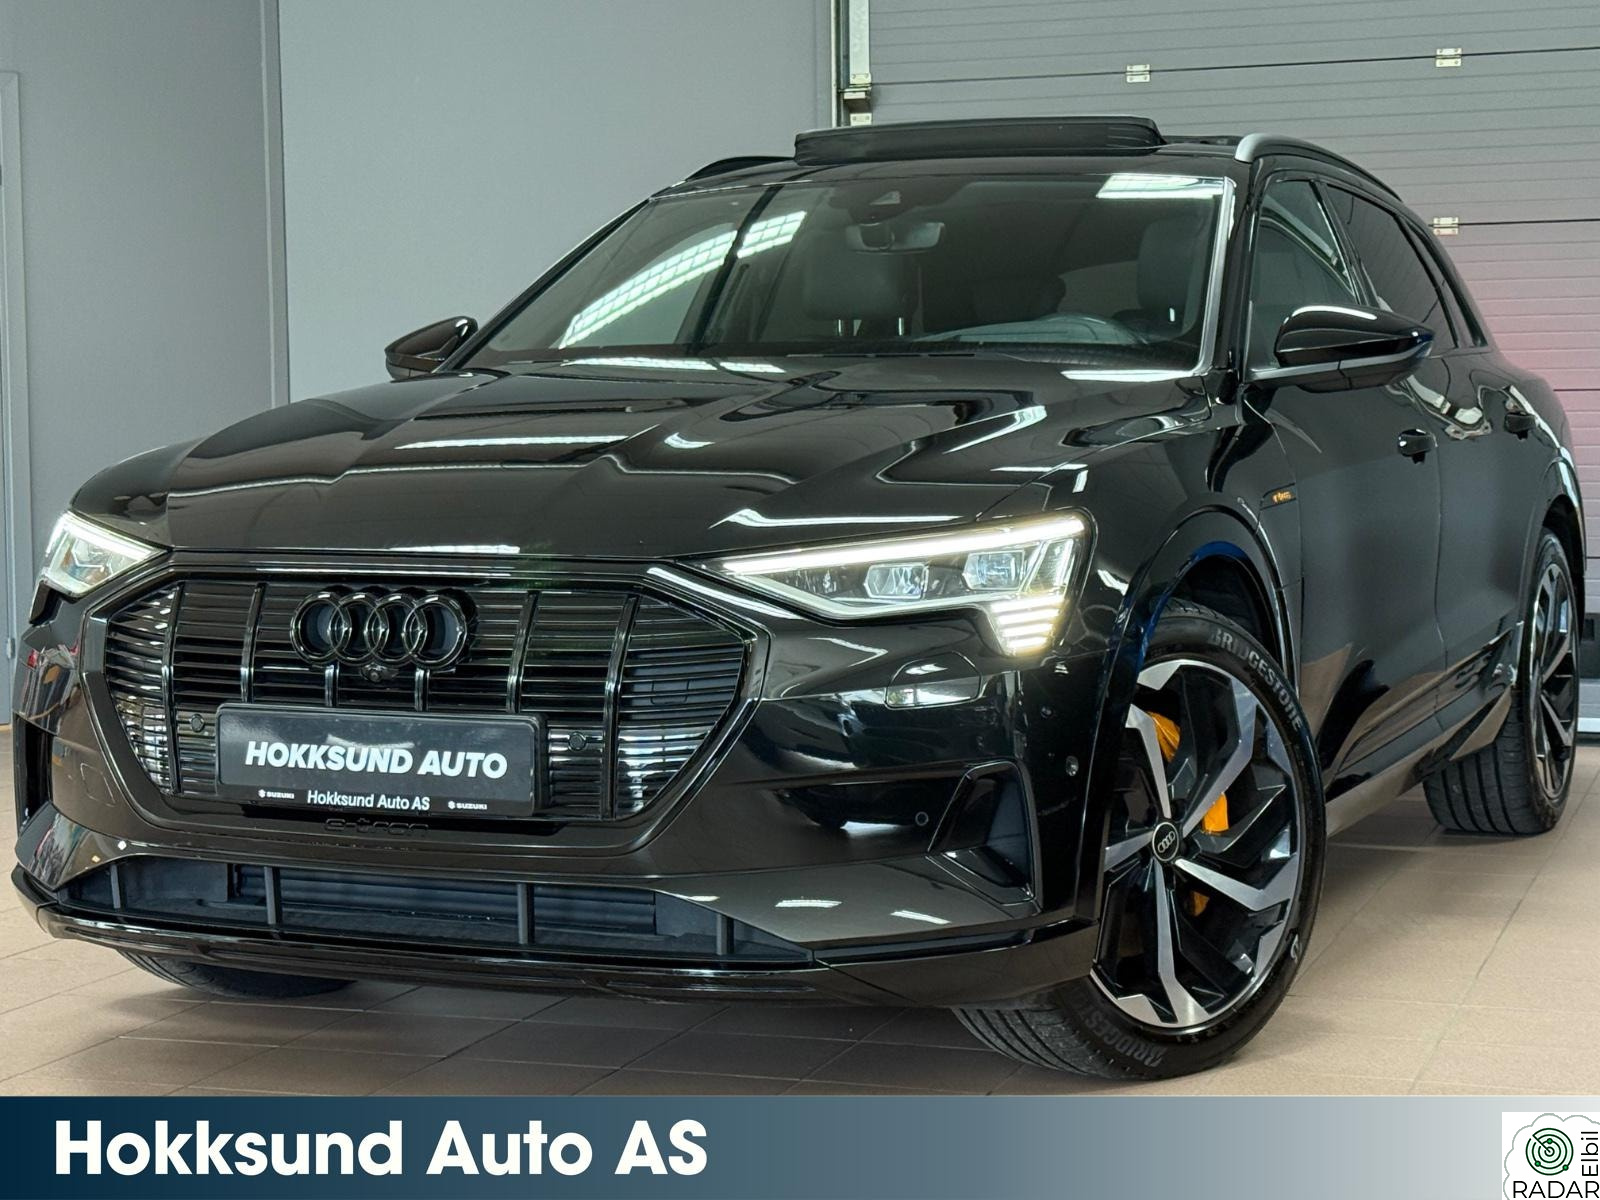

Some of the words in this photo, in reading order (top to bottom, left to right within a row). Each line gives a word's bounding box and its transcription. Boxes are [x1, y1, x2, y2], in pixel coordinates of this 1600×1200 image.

[1207, 627, 1303, 733] BRIDGESTONE
[244, 740, 414, 775] HOKKSUND
[417, 749, 508, 780] AUTO
[266, 791, 295, 800] SUZUKI
[307, 790, 374, 808] Hokksund
[377, 794, 410, 810] Auto
[411, 796, 431, 811] AS
[456, 802, 488, 811] SUZUKI
